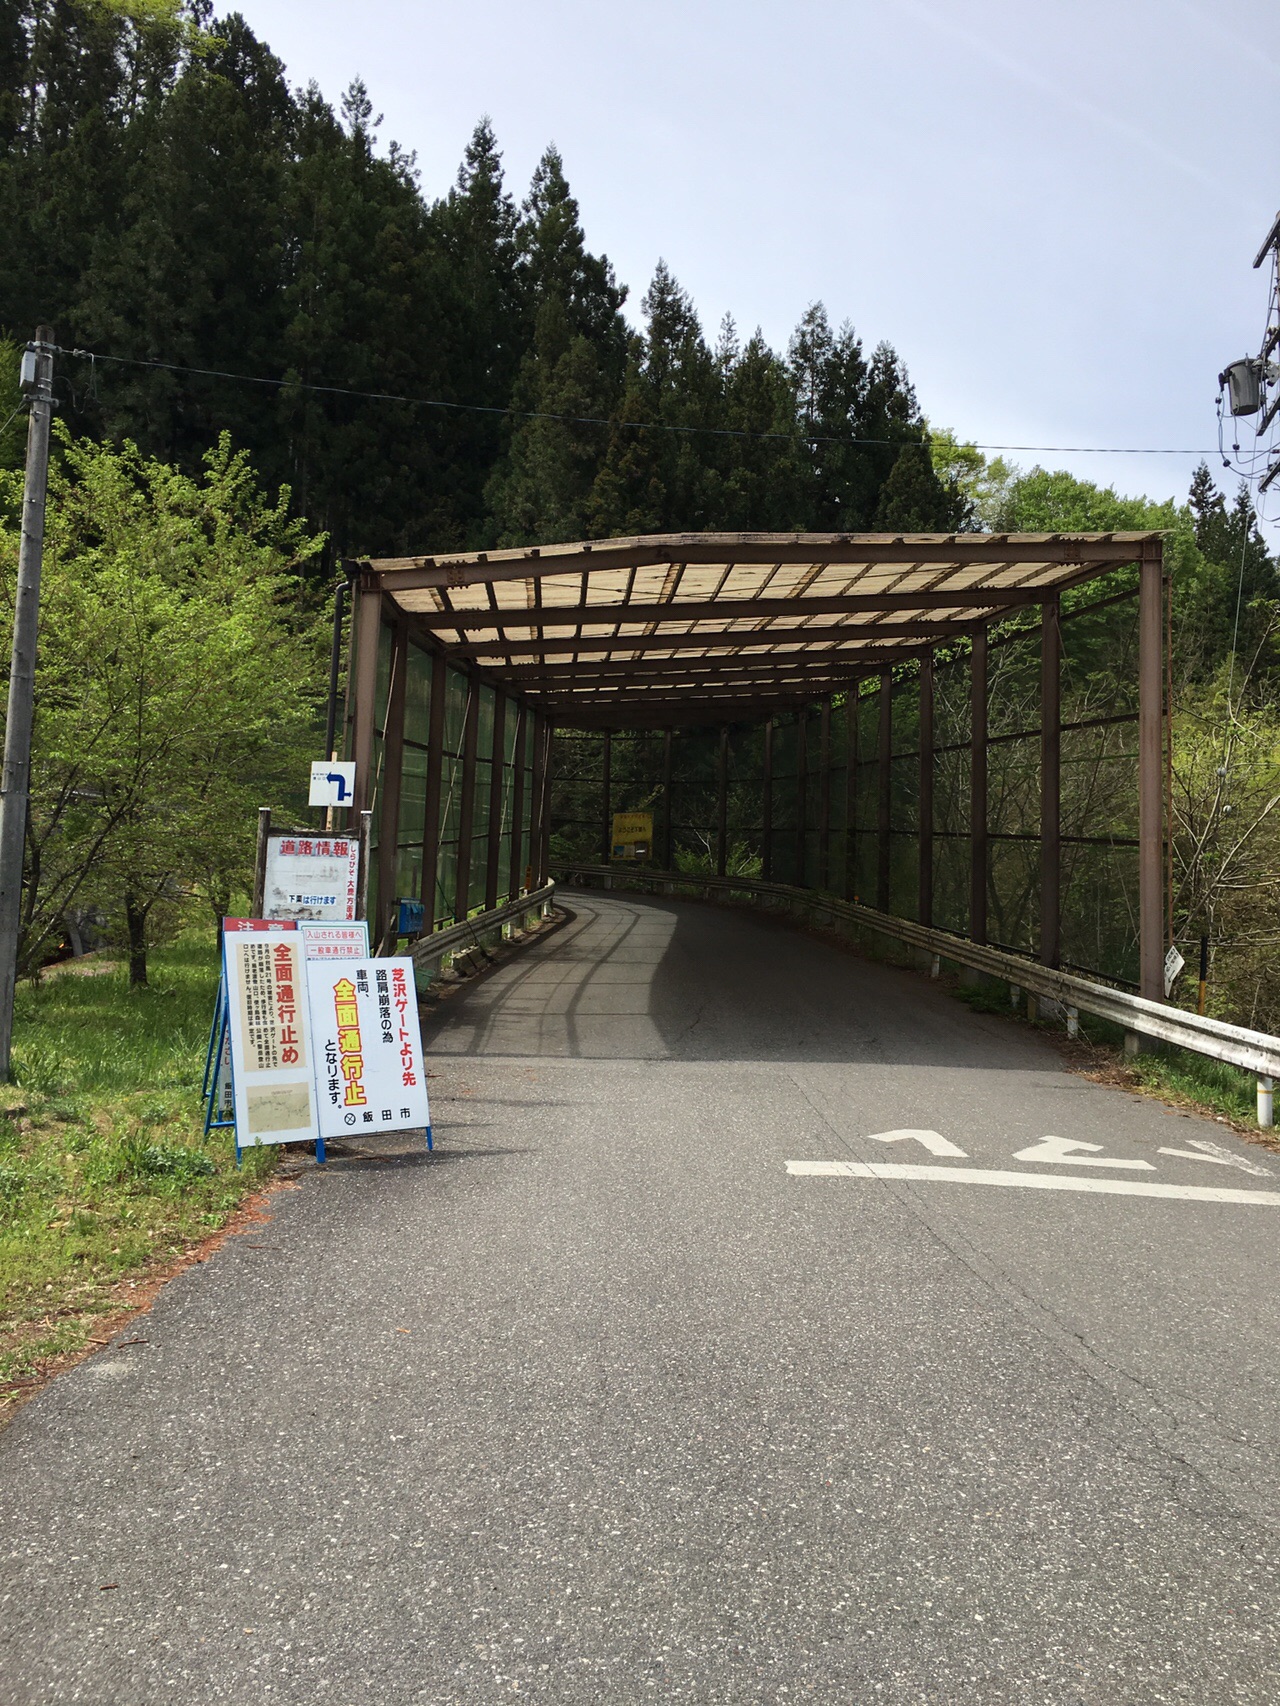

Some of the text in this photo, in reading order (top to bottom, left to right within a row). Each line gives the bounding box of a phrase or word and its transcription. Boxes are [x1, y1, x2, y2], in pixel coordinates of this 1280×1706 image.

[280, 840, 349, 856] 道路情報
[307, 930, 362, 939] 入山される皆様へ
[310, 946, 360, 955] 一般車通行禁止
[273, 943, 299, 1064] 全面通行止め
[375, 969, 394, 1044] 路肩崩落の為
[391, 967, 417, 1087] 芝沢ゲートより先
[324, 1038, 342, 1109] となります。
[332, 977, 367, 1107] 全面通行止
[362, 1107, 411, 1123] 飯田市
